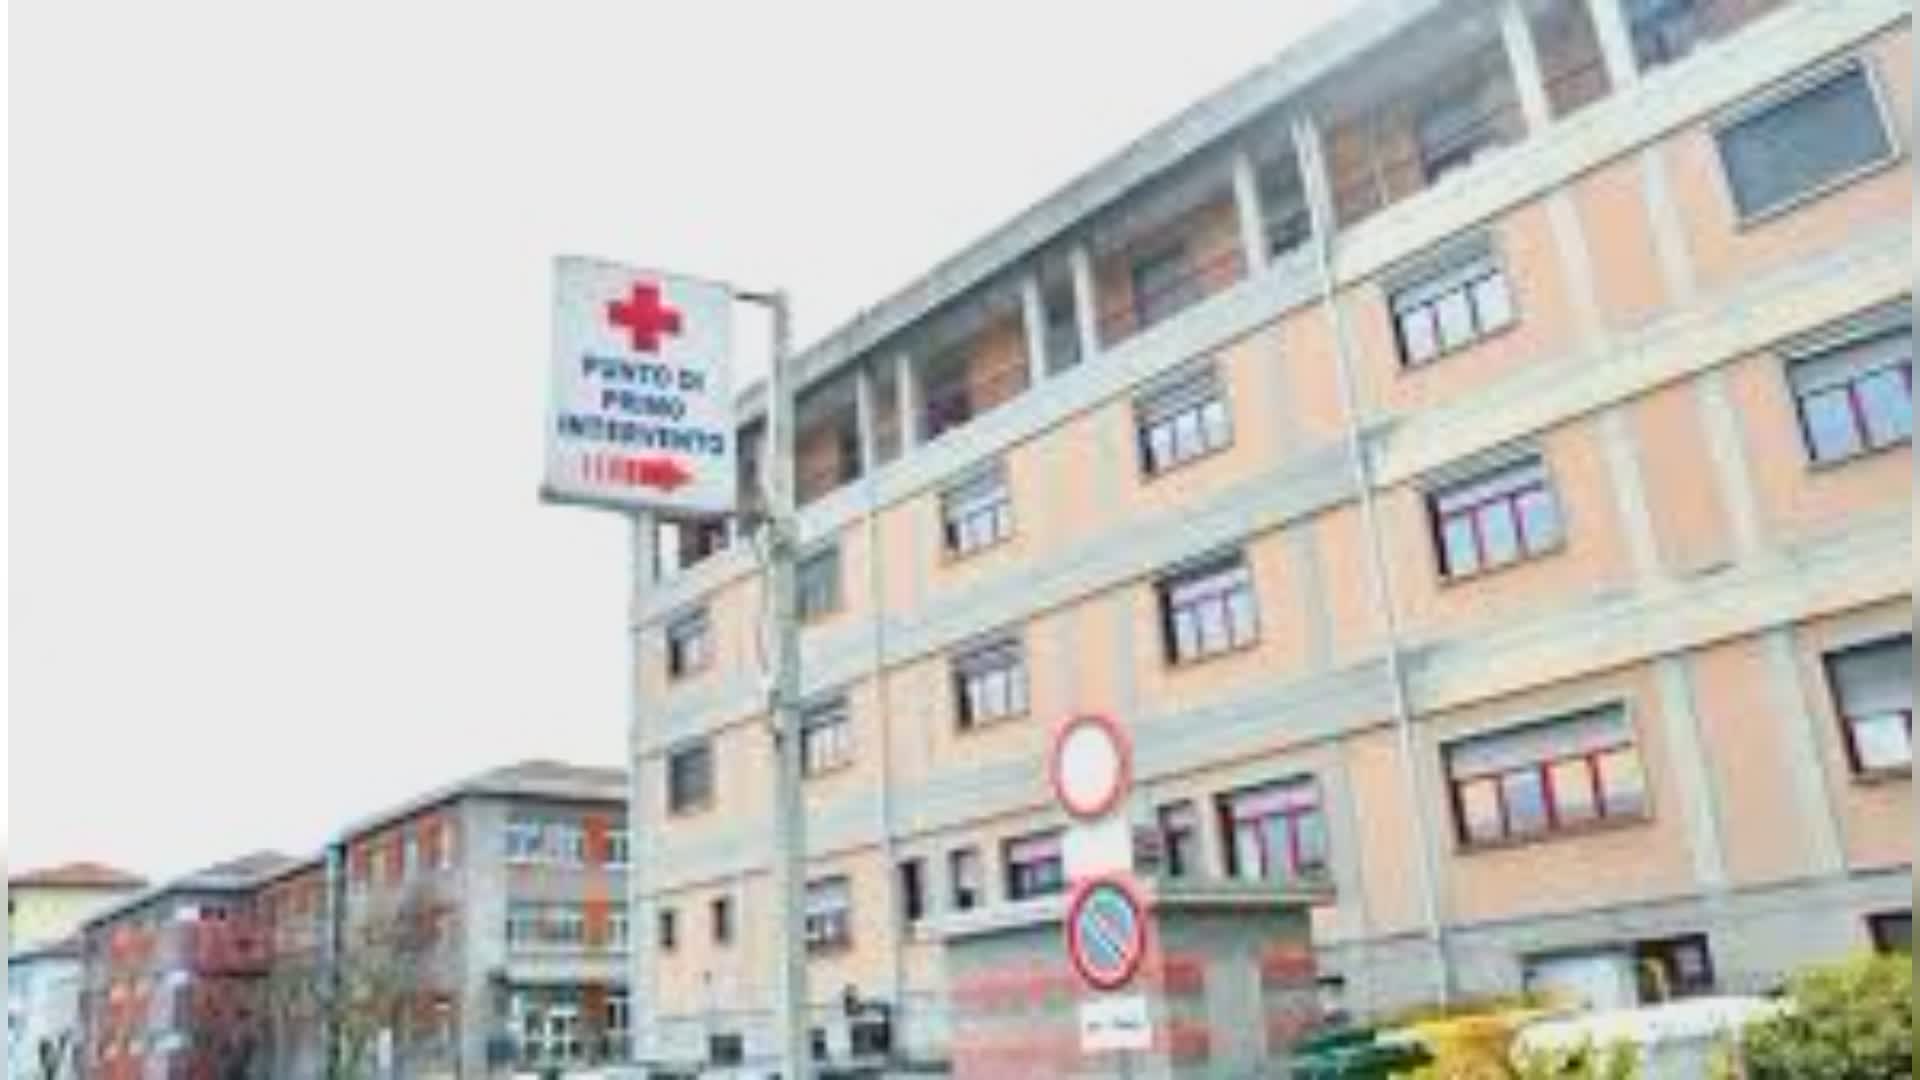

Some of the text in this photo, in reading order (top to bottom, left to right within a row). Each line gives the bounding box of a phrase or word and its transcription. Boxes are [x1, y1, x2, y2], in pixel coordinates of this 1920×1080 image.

[582, 355, 705, 391] PUNTO DI
[601, 389, 686, 421] PRIMO
[557, 413, 725, 455] INTERVENTO
